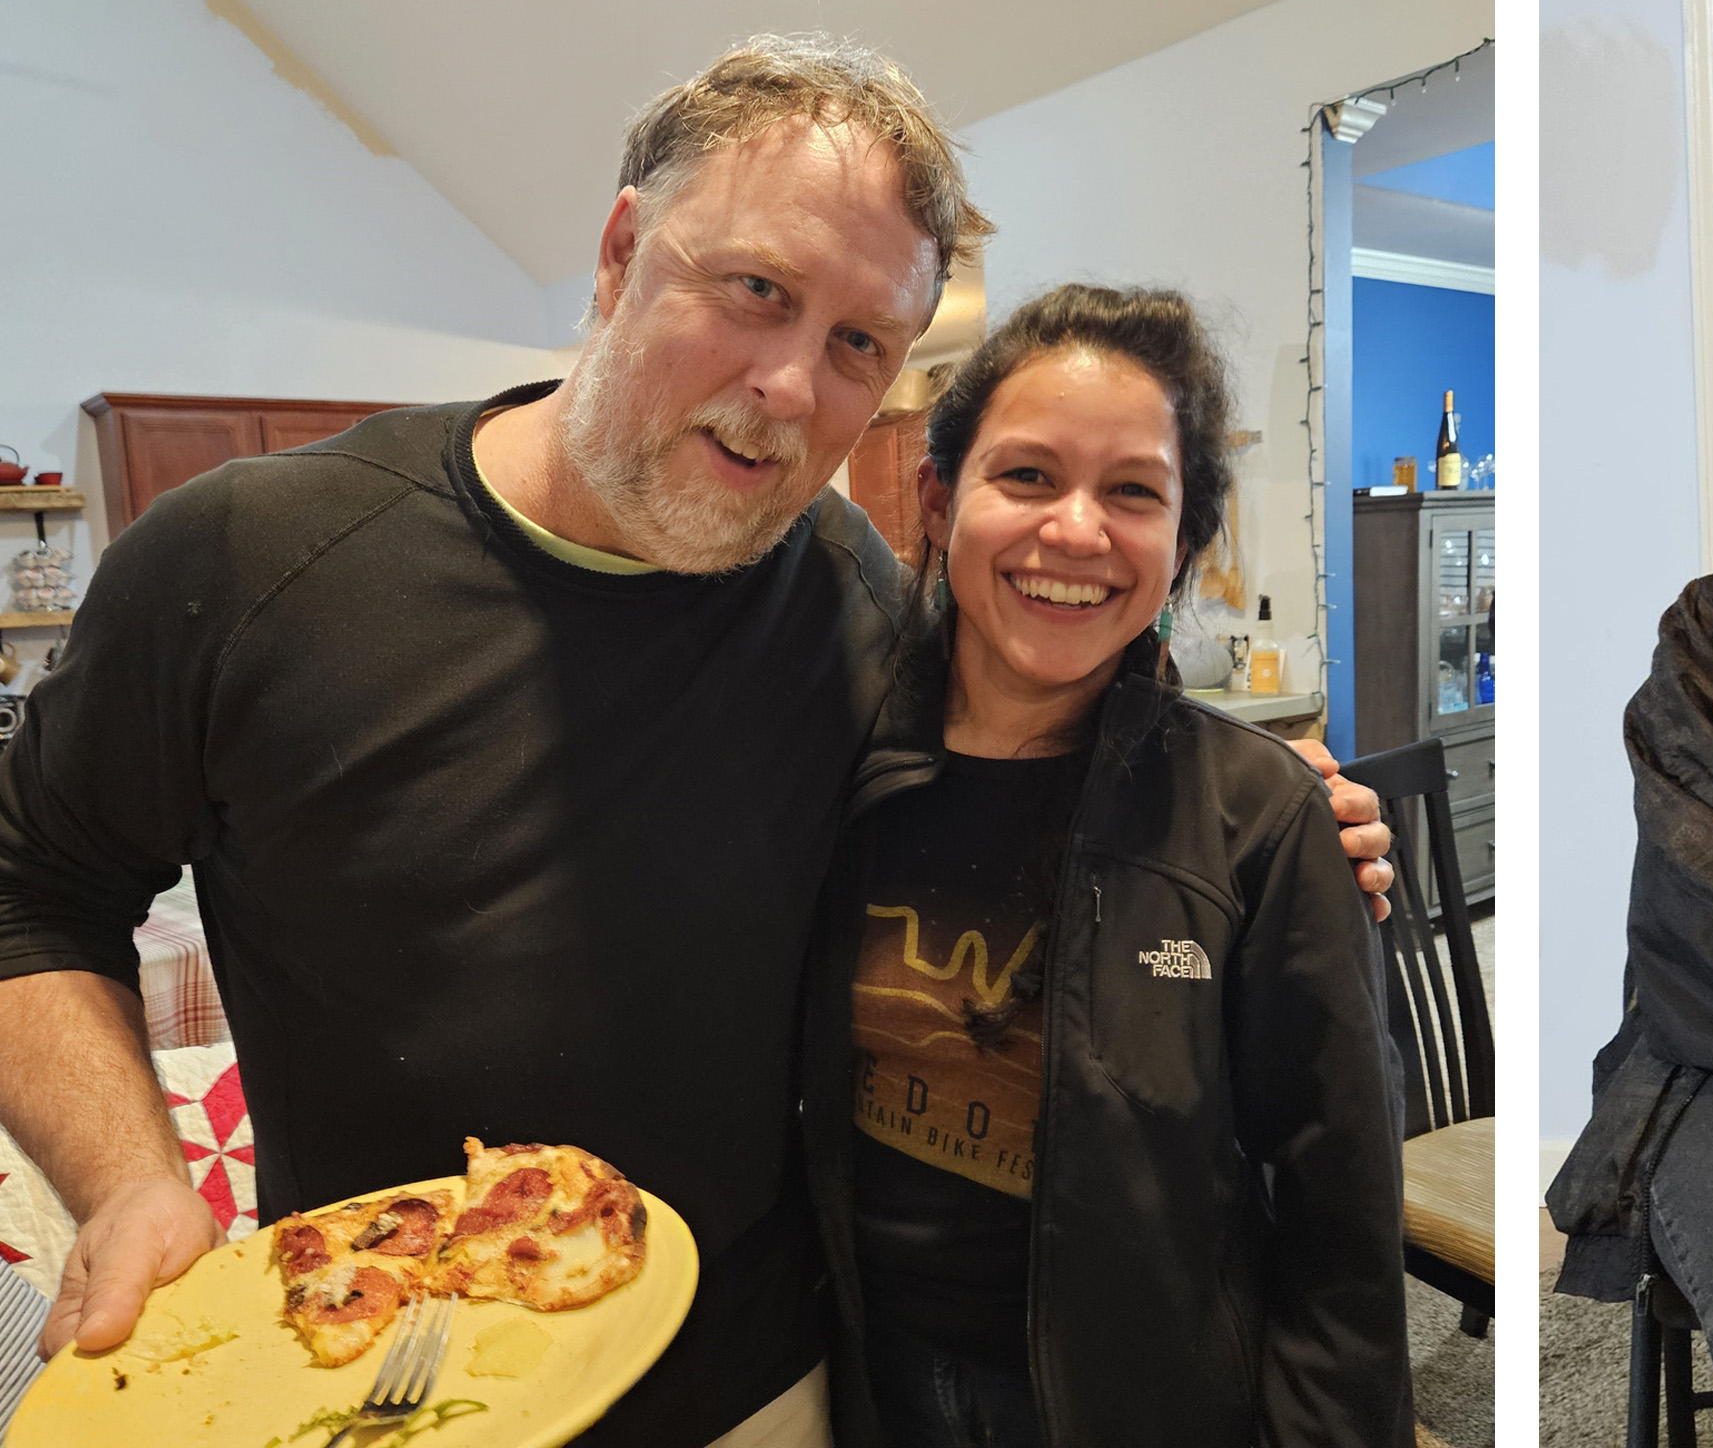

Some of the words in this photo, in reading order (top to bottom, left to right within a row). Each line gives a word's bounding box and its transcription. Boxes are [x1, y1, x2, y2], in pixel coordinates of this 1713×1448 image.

[1161, 939, 1192, 953] THE
[1138, 950, 1192, 966] NORTH
[1153, 964, 1192, 979] FACE
[927, 1126, 981, 1161] BIKE
